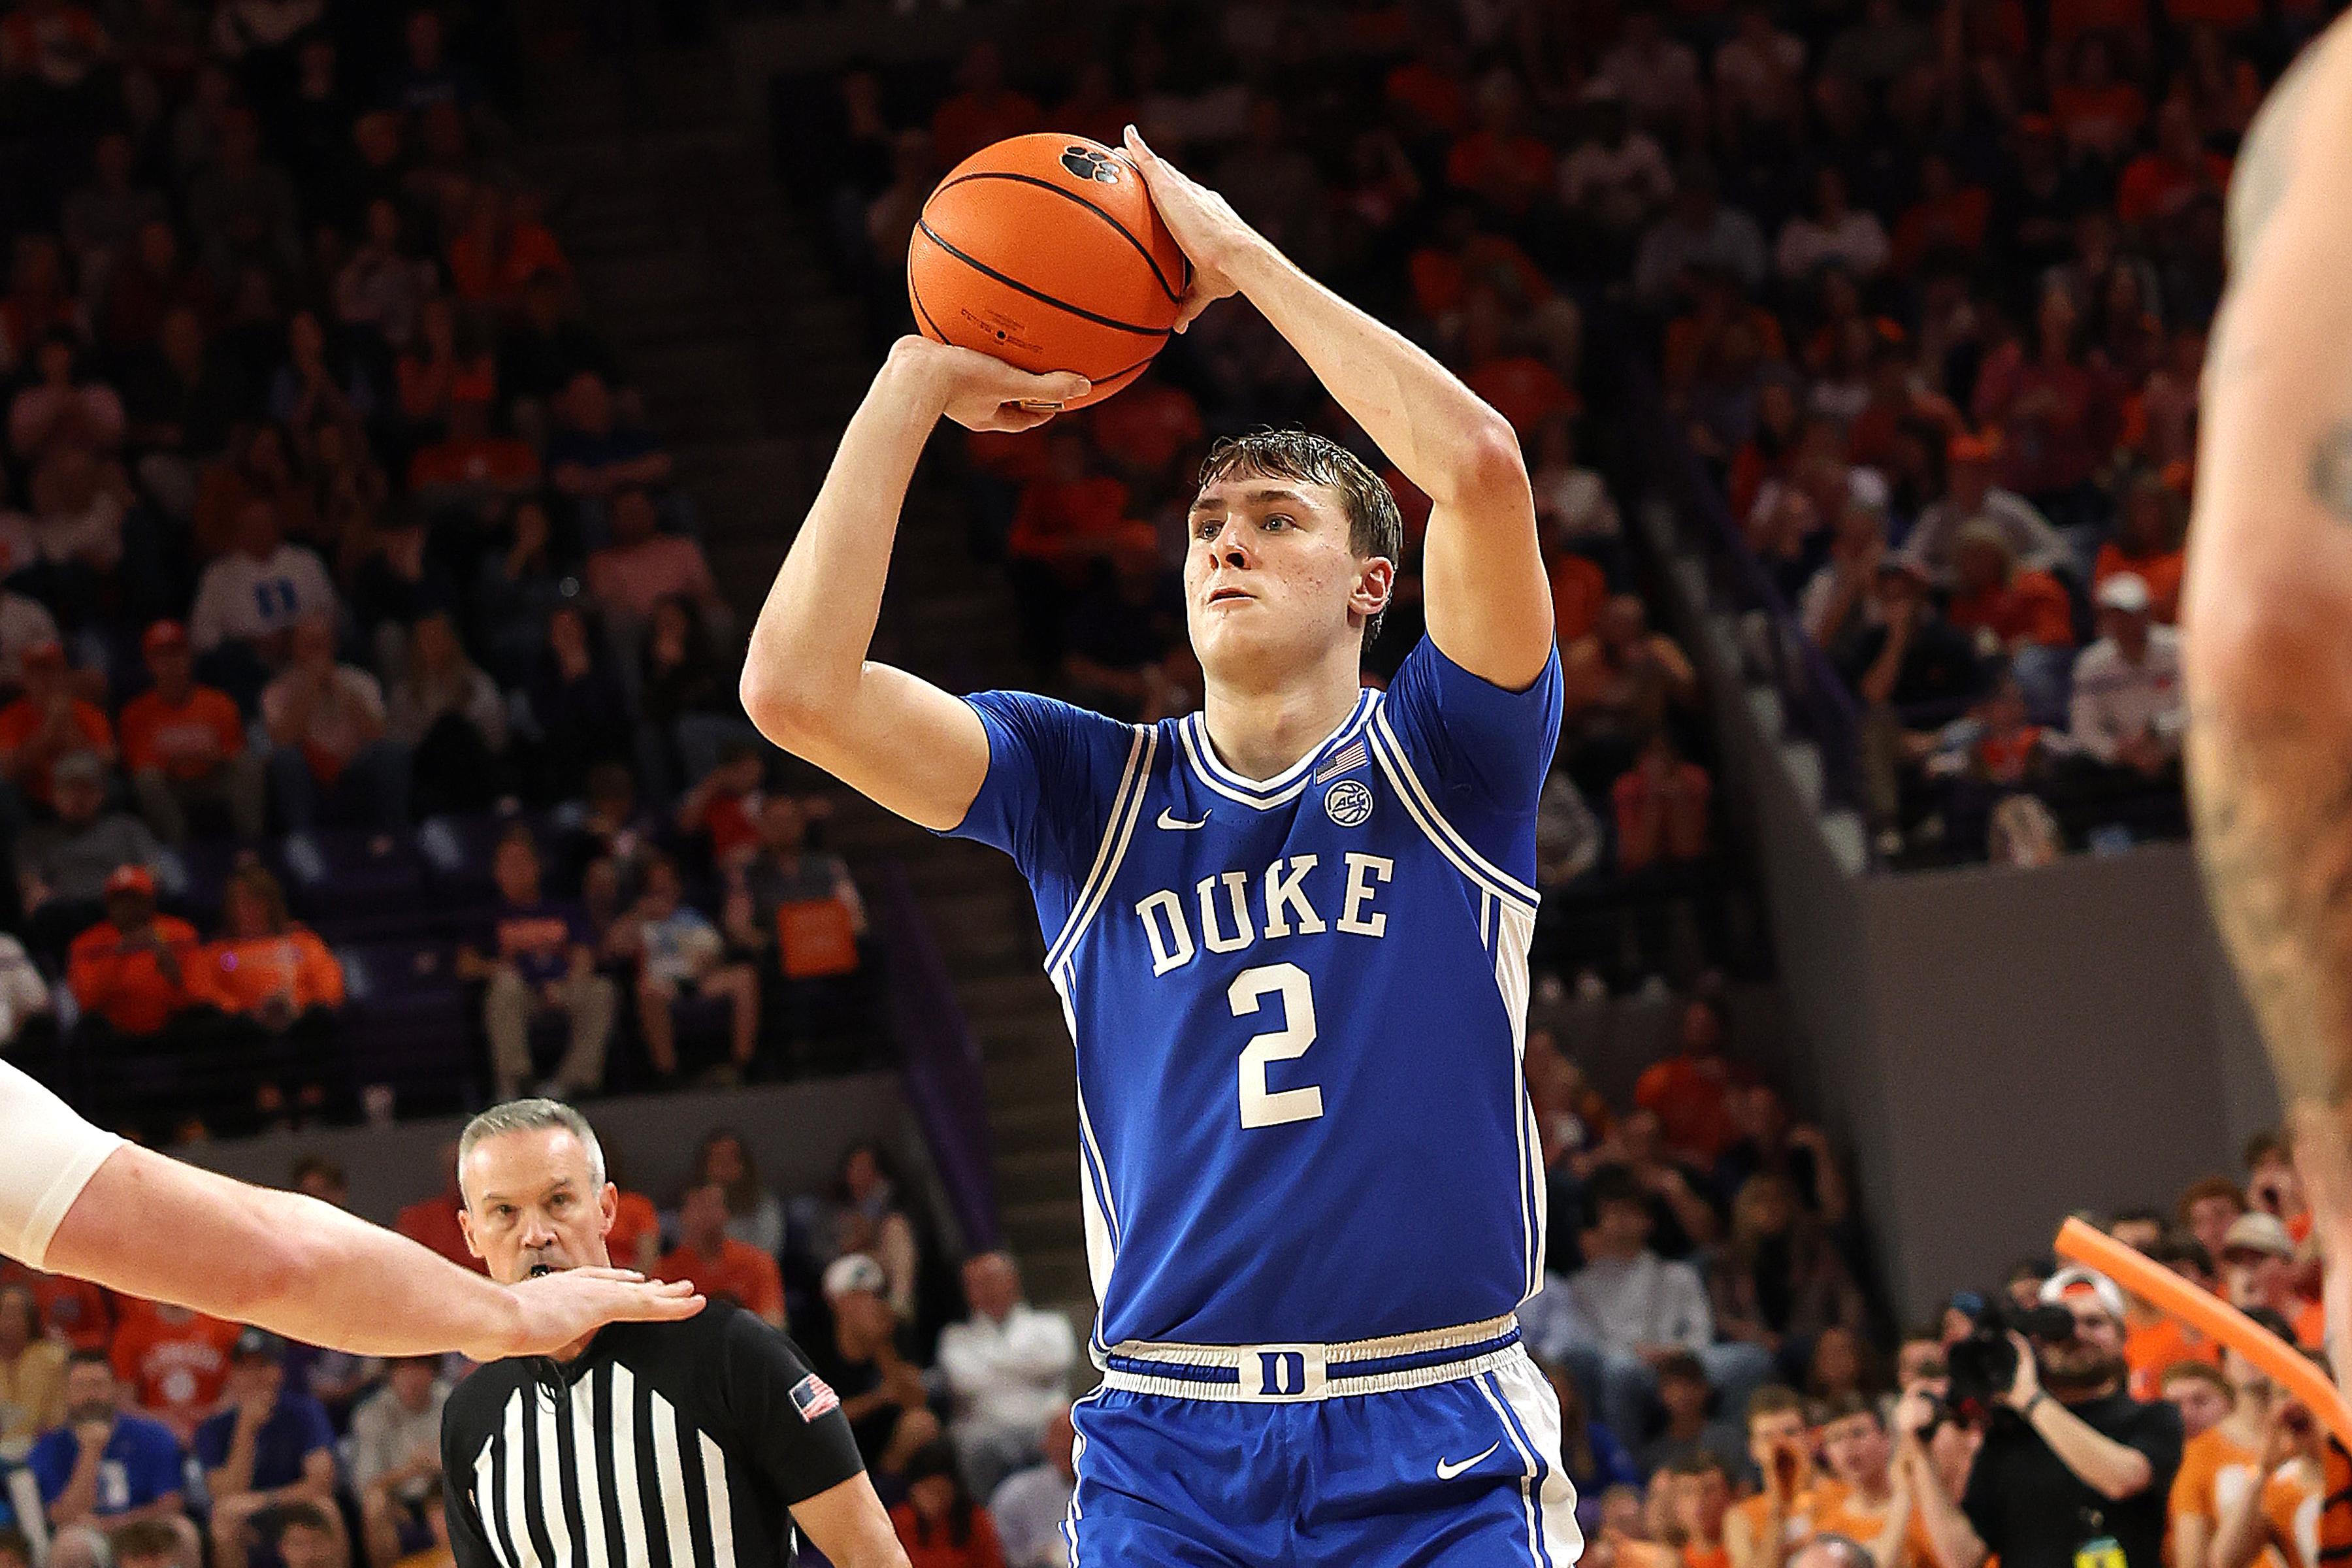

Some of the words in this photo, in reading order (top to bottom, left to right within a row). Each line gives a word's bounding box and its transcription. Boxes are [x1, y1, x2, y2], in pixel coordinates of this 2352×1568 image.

[1334, 791, 1366, 808] ACC
[1135, 853, 1394, 977] DUKE
[1228, 962, 1323, 1129] 2
[1256, 1352, 1305, 1395] D
